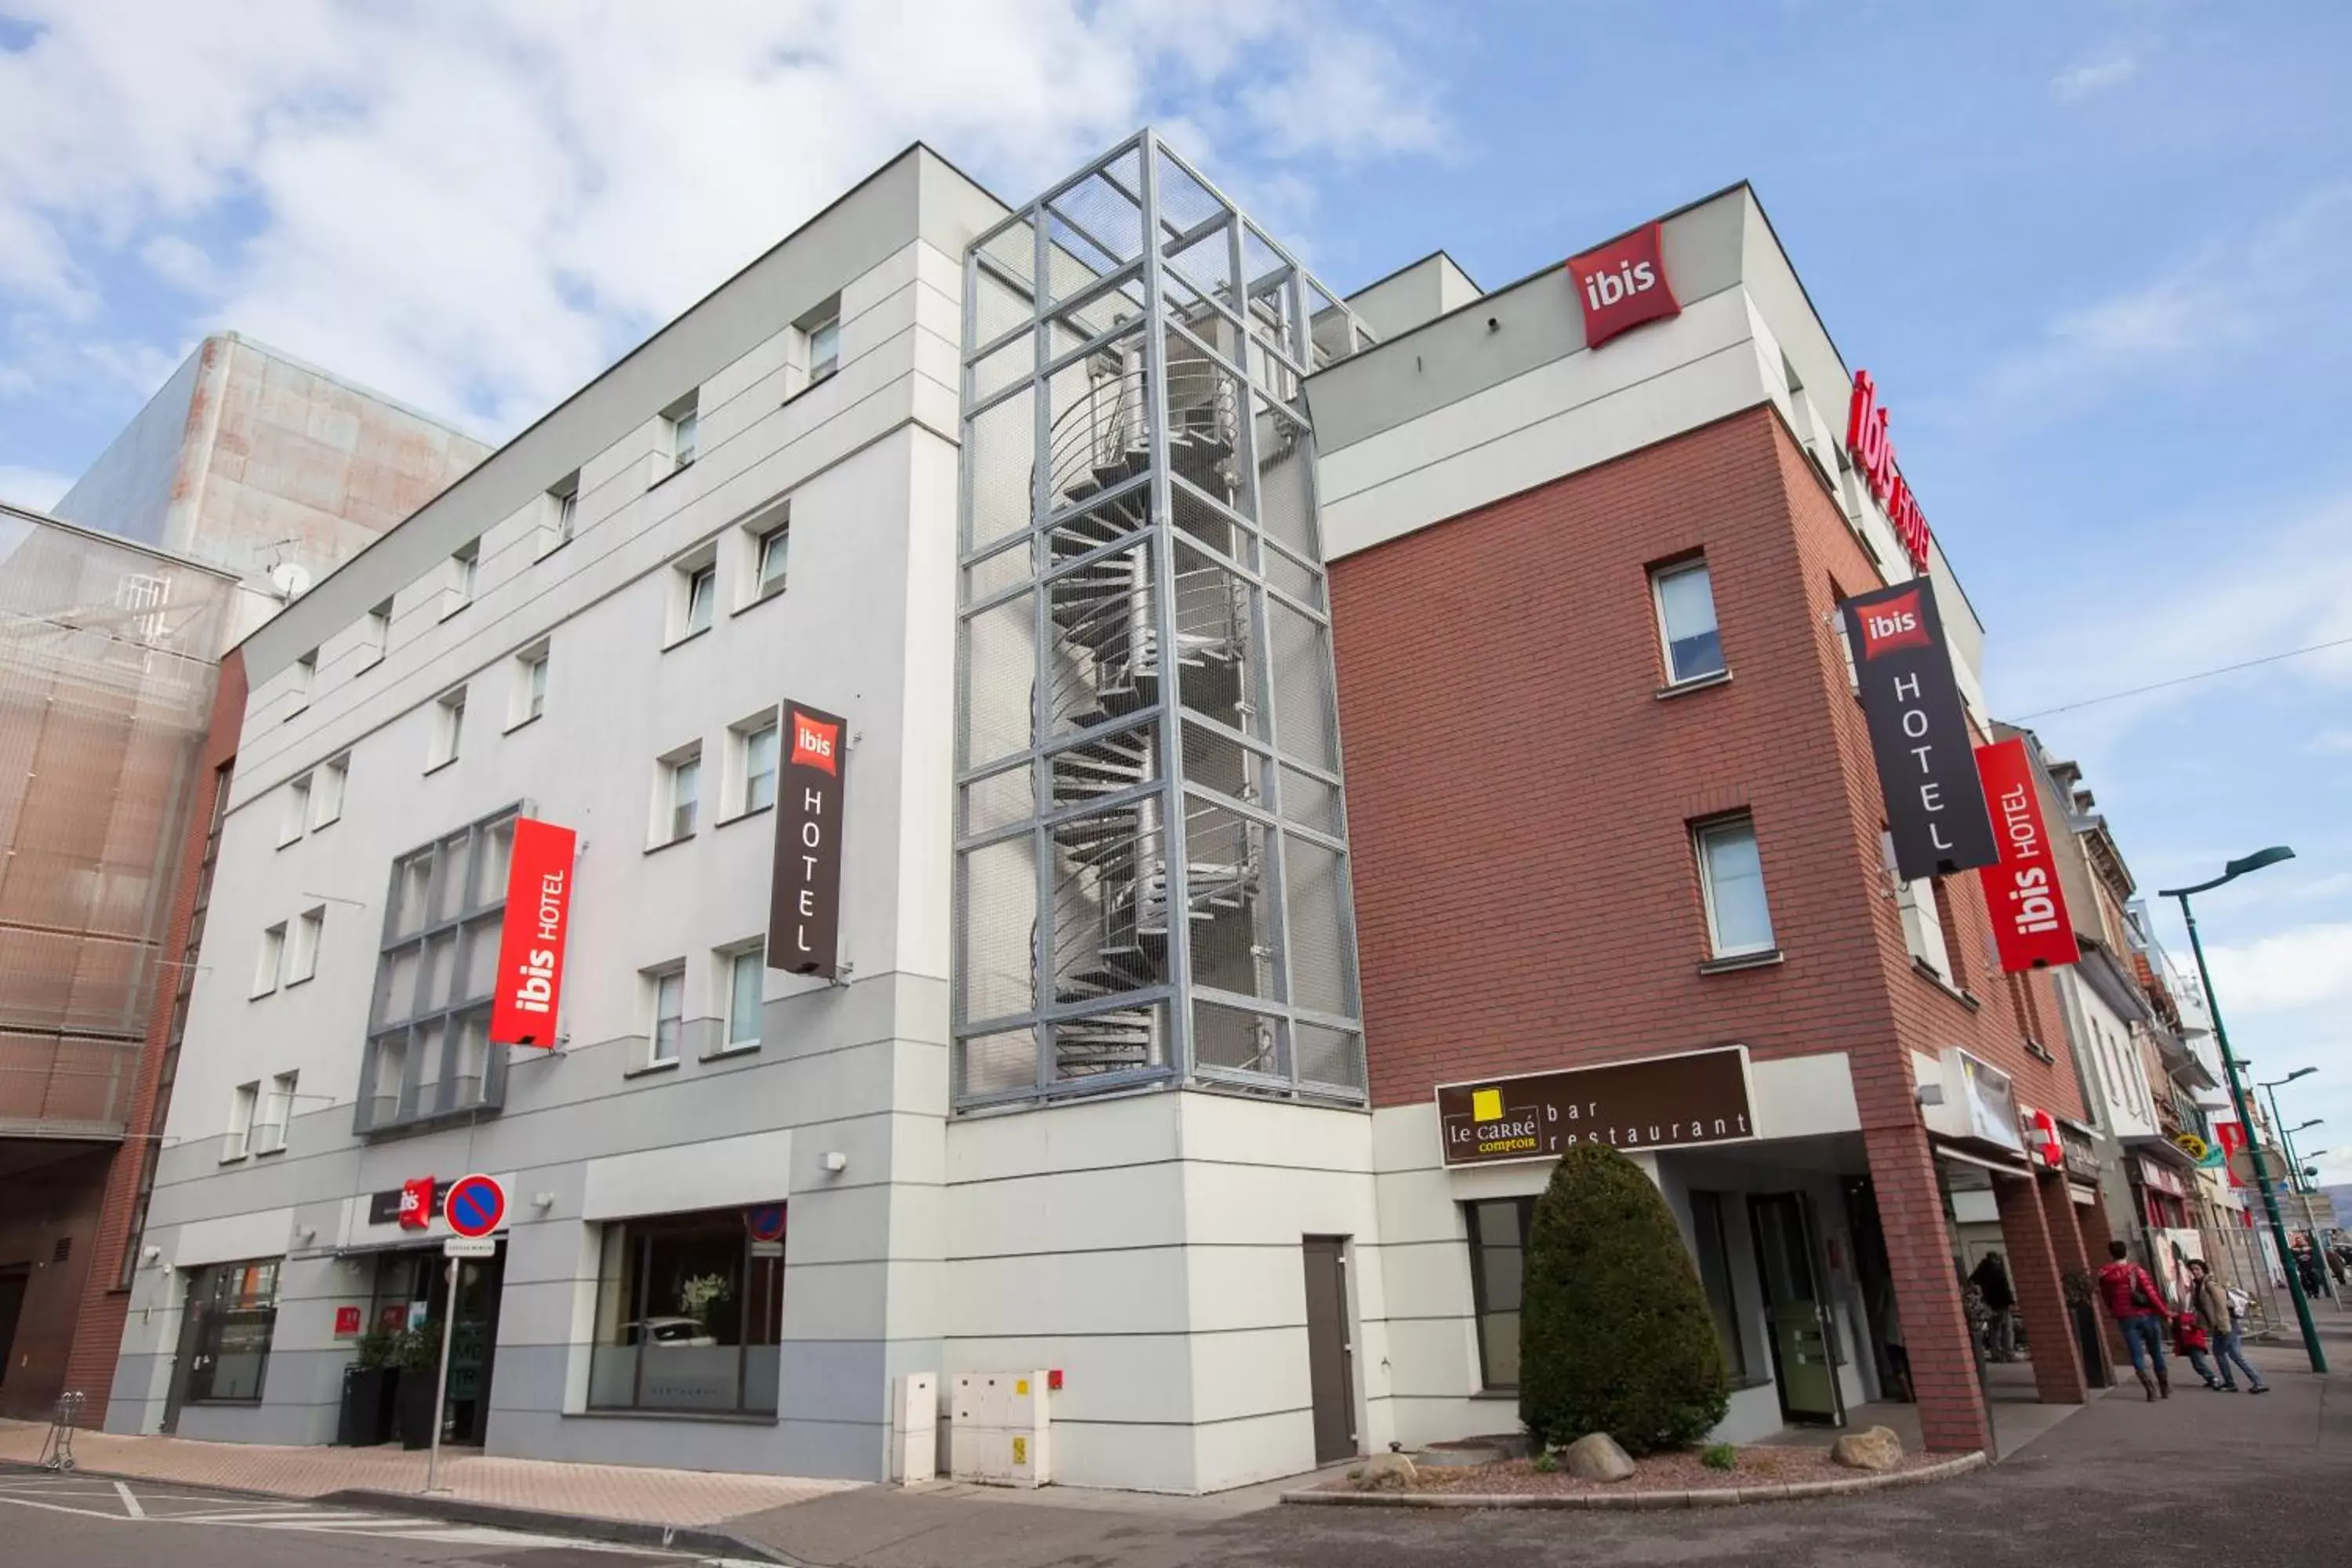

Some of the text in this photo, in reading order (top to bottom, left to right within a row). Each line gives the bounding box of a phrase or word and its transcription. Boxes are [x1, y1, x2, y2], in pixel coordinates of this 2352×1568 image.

[1584, 259, 1655, 310] ibis
[1848, 369, 1895, 500] ibis
[1868, 610, 1917, 641] ibis
[799, 727, 831, 757] ibis
[1893, 671, 1952, 851] HOTEL
[798, 787, 822, 952] HOTEL
[2001, 782, 2058, 935] ibis HOTEL
[515, 869, 564, 1014] ibis HOTEL
[1450, 1125, 1471, 1143] Le
[1546, 1102, 1598, 1122] bar
[1549, 1112, 1748, 1151] restaurant
